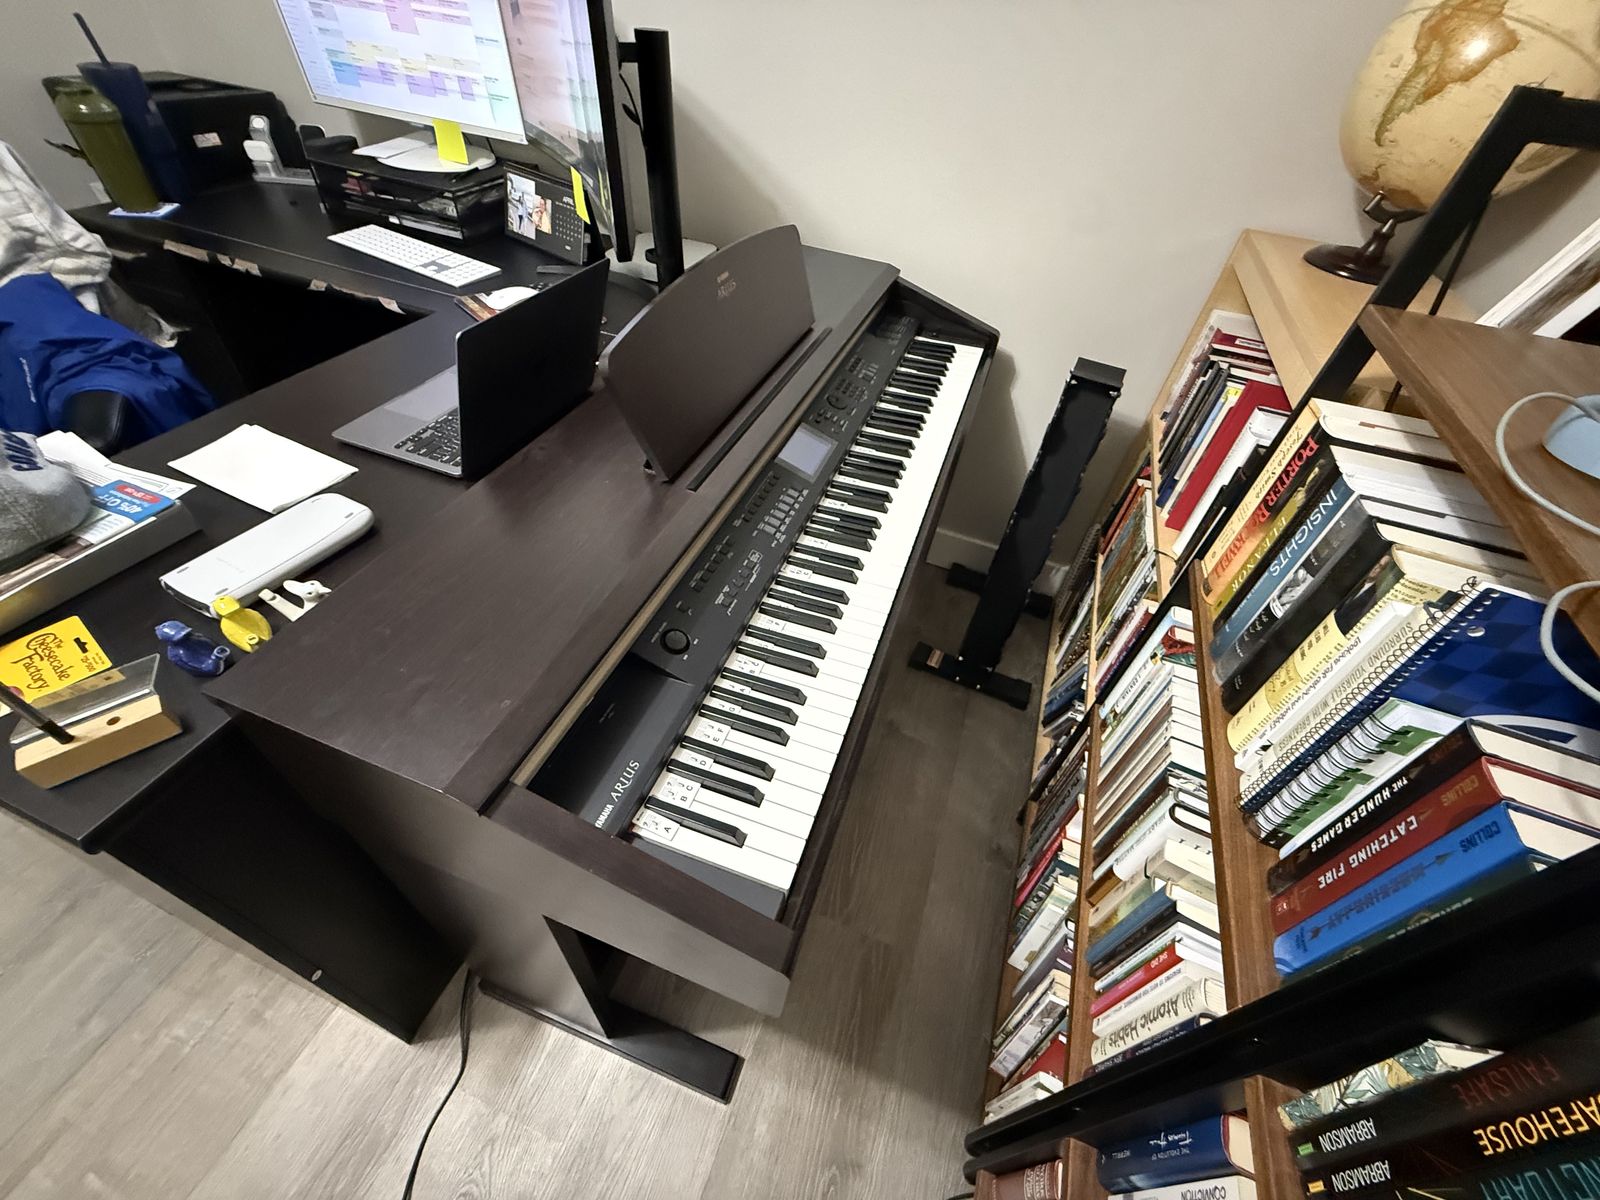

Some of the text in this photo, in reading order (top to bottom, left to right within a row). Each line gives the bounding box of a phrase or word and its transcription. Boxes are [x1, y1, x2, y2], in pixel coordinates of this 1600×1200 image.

[1263, 434, 1319, 506] PORTER
[1229, 515, 1287, 592] ELEANOR
[1267, 488, 1337, 577] INSIGHTS
[26, 632, 75, 681] Cheesecake
[1365, 621, 1413, 669] SURROUND
[10, 648, 51, 690] Factory
[1324, 663, 1366, 705] YOURSELF
[1308, 698, 1330, 722] WITH
[1274, 714, 1312, 753] GREATNESS
[594, 759, 641, 829] YAMAHA ARIUS
[1439, 773, 1479, 807] COLLINS
[1310, 775, 1408, 853] THE HUNGER GAMES
[1315, 814, 1417, 890] CATCHING FIRE
[1457, 818, 1501, 854] COLLINS
[1106, 1018, 1139, 1050] Habits
[1137, 994, 1178, 1033] Atomic
[1452, 1054, 1560, 1110] FAILSAFE
[1318, 1116, 1378, 1153] ABRAMSON
[1472, 1094, 1600, 1157] AFEHOUSE
[1181, 1185, 1227, 1200] CONVICTION
[1330, 1159, 1392, 1193] ABRAMSON
